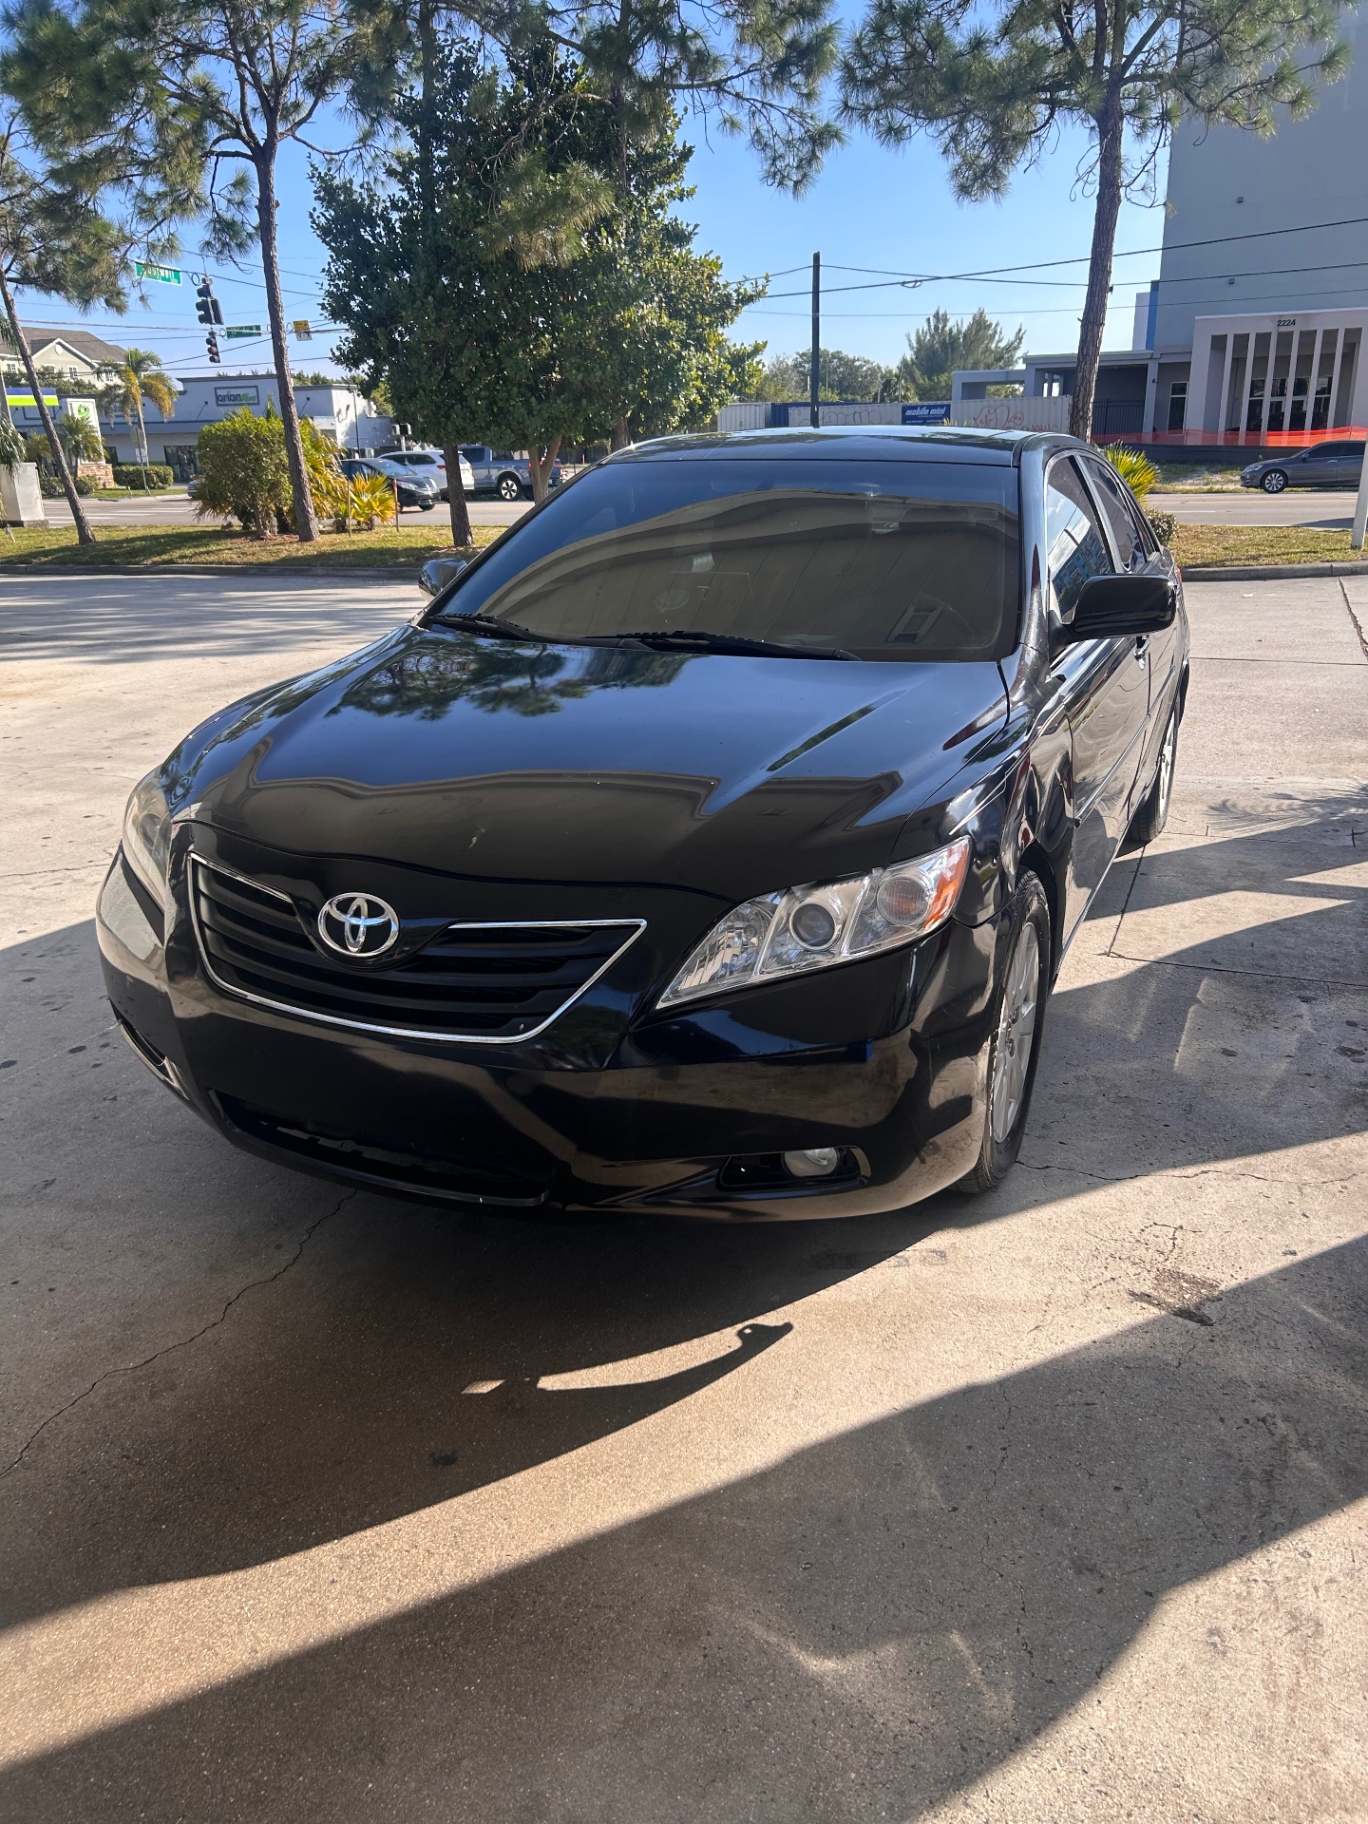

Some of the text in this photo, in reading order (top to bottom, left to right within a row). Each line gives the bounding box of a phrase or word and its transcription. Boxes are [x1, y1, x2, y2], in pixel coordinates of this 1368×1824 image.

[1277, 318, 1297, 326] 2224
[905, 406, 929, 416] mobile
[930, 406, 947, 415] mini
